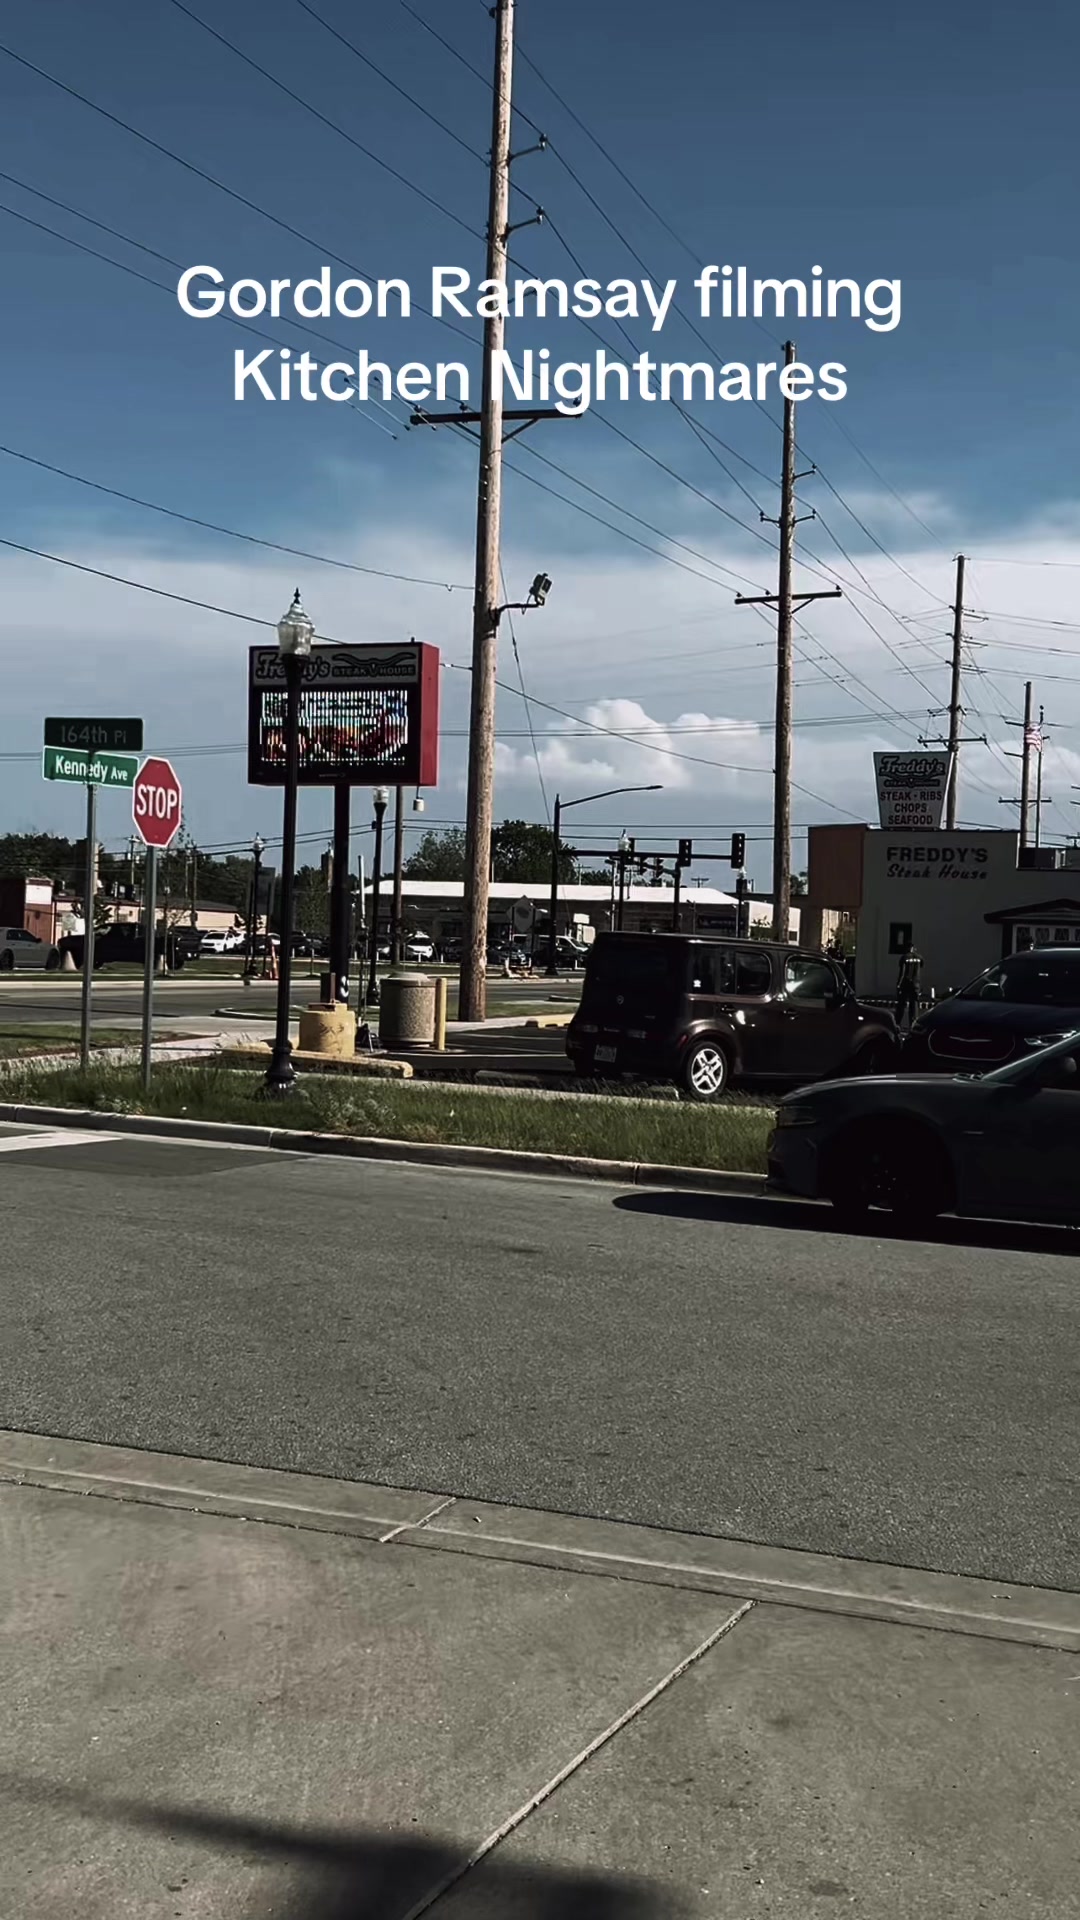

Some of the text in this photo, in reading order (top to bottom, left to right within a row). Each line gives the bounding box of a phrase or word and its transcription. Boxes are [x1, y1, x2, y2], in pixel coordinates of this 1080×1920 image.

[256, 652, 330, 681] Frey's
[333, 665, 415, 677] STEAK HOUSE
[61, 725, 107, 743] 164th
[55, 755, 128, 782] Kennedy Ave
[879, 756, 945, 775] Freddy's
[136, 784, 178, 819] STOP
[880, 791, 942, 801] STEAK RIBS
[894, 803, 927, 813] CHOPS
[888, 815, 933, 825] SEAFOOD
[887, 847, 988, 862] FREDDY'S
[887, 864, 988, 879] Steak House
